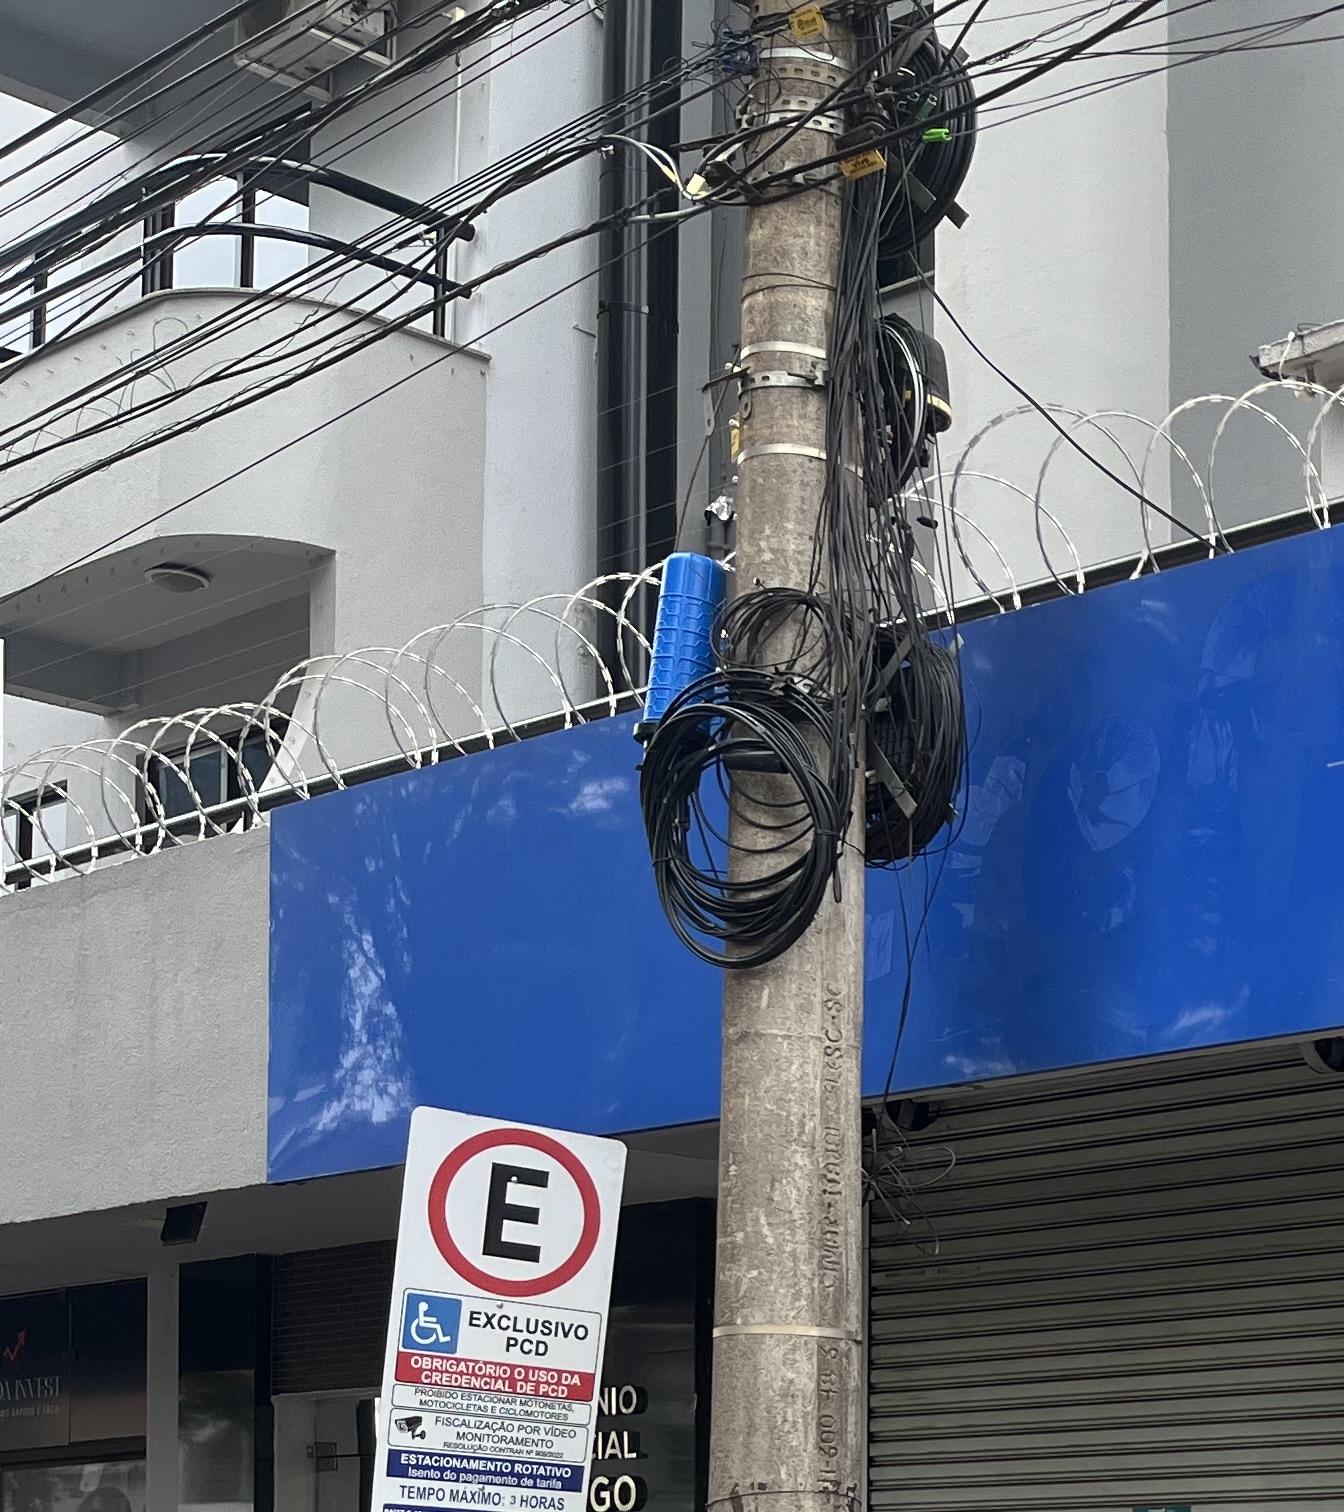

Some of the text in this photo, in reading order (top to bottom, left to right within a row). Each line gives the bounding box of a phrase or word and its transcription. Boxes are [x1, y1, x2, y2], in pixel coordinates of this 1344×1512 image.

[482, 1161, 550, 1264] E
[467, 1309, 590, 1342] EXCLUSIVO
[504, 1335, 549, 1358] PCD
[410, 1355, 582, 1387] OBRIGATÓRIO O USO DA
[414, 1387, 458, 1400] PROIBIDO
[460, 1392, 518, 1407] ESTACIONAR
[420, 1371, 568, 1399] CREDENCIAL DE PCD
[418, 1398, 569, 1422] MOTOCICLETAS E CICLOMOTORES
[434, 1416, 577, 1439] FISCALIZAÇÃO POR VÍDEO
[455, 1430, 554, 1449] MONITORAMENTO
[489, 1446, 525, 1455] CONTRAN
[593, 1430, 637, 1460] IAL
[400, 1453, 572, 1478] ESTACIONAMENTO ROTATIVO
[408, 1466, 562, 1490] Isento do pagamento de tarifa
[399, 1484, 566, 1511] TEMPO MÁXIMO: 3 HORAS
